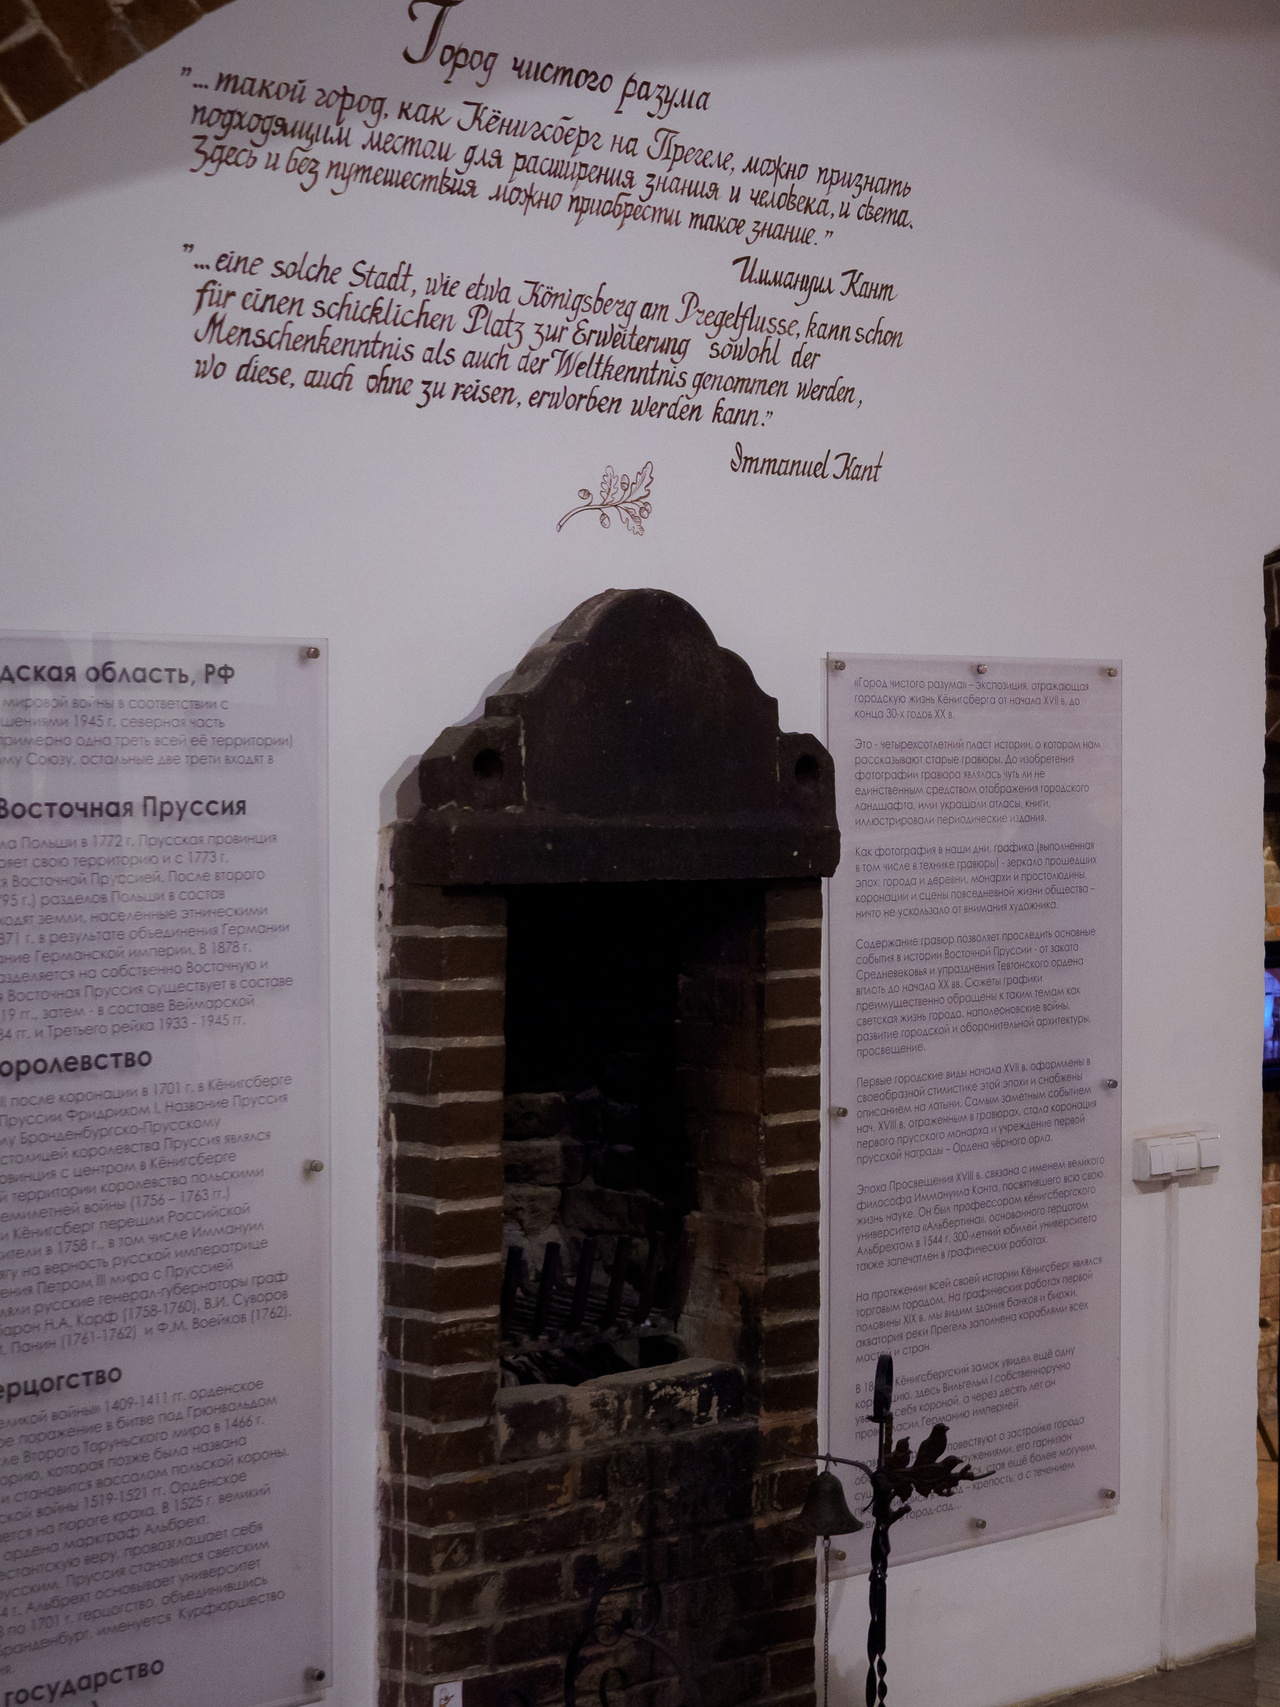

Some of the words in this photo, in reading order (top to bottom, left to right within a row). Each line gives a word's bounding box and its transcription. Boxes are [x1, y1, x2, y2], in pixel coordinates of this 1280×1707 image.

[403, 0, 498, 88] Город
[512, 57, 613, 93] чистого
[614, 72, 711, 120] разума
[314, 85, 388, 128] город,
[397, 100, 453, 126] как
[457, 100, 603, 157] Кёнигсберг
[610, 134, 638, 157] на
[647, 127, 735, 175] Прегеле,
[742, 155, 808, 187] можно
[816, 164, 912, 198] признать
[190, 104, 352, 148] подходящим
[362, 130, 456, 162] местом
[455, 144, 504, 175] для
[508, 151, 637, 191] расширения
[639, 172, 722, 202] знания
[728, 185, 741, 204] и
[750, 183, 834, 219] человека,
[839, 200, 850, 219] и
[857, 196, 913, 229] света.
[190, 135, 257, 176] Здесь
[264, 151, 280, 171] и
[286, 146, 320, 192] без
[326, 158, 479, 198] путешествия
[489, 179, 563, 219] можно
[568, 191, 681, 230] приобрести
[689, 211, 746, 236] такое
[271, 251, 342, 285] solche
[349, 260, 417, 297] Stadt,
[426, 272, 460, 298] wie
[466, 273, 511, 304] etwa
[518, 280, 638, 328] Königsberg
[640, 301, 669, 323] am
[675, 291, 801, 342] Pregelflusse,
[805, 311, 851, 342] kann
[855, 316, 903, 348] schon
[732, 256, 835, 306] Иммануил
[840, 269, 898, 301] Кант
[193, 279, 236, 316] für
[242, 288, 304, 317] einen
[312, 292, 457, 334] schicklichen
[463, 304, 525, 349] Platz
[529, 322, 568, 350] zur
[572, 319, 691, 364] Erweiterung
[709, 336, 781, 366] sowohl
[791, 342, 821, 370] der
[194, 312, 415, 362] Menschenkenntnis
[422, 338, 456, 366] als
[462, 344, 512, 372] auch
[517, 349, 551, 376] der
[551, 348, 687, 389] Weltkenntnis
[685, 370, 788, 400] genommen
[797, 376, 862, 409] werden,
[194, 353, 227, 380] wo
[236, 354, 295, 389] diese,
[304, 363, 356, 392] auch
[366, 364, 413, 396] ohne
[415, 378, 446, 408] zu
[451, 379, 521, 409] reisen,
[528, 386, 622, 415] erworben
[630, 395, 703, 423] werden
[731, 442, 829, 480] Immanuel
[833, 451, 883, 482] Kant
[86, 661, 196, 686] область,
[204, 663, 235, 685] РФ
[889, 679, 925, 688] чистого
[975, 681, 1029, 692] экспозиция,
[1031, 683, 1088, 693] отражающая
[854, 694, 906, 705] городскую
[908, 695, 935, 703] жизнь
[937, 693, 995, 706] Кёнигсберга
[1009, 696, 1041, 705] начала
[854, 709, 883, 719] конца
[885, 708, 904, 718] 30-х
[906, 710, 932, 719] годов
[142, 795, 247, 822] Пруссия
[854, 786, 923, 795] единственным
[925, 785, 976, 796] средством
[978, 784, 1038, 795] отображения
[1040, 784, 1089, 794] городского
[21, 836, 77, 849] Польши
[93, 833, 122, 847] 1772
[138, 833, 204, 848] Прусская
[207, 833, 277, 846] провинция
[855, 937, 918, 949] Содержание
[920, 936, 954, 947] гравюр
[956, 933, 999, 943] позволяет
[1001, 930, 1052, 942] проследить
[1054, 928, 1095, 938] основные
[8, 988, 80, 1001] Восточная
[84, 984, 143, 999] Пруссия
[147, 980, 226, 996] существует
[240, 976, 293, 989] составе
[11, 1094, 55, 1106] после
[58, 1088, 138, 1103] коронации
[153, 1081, 179, 1095] 1701
[207, 1074, 292, 1090] Кёнигсберге
[856, 1183, 886, 1195] Эпоха
[889, 1175, 953, 1192] Просвещения
[984, 1166, 1019, 1178] связана
[1029, 1161, 1065, 1172] именем
[1067, 1156, 1104, 1168] великого
[856, 1195, 911, 1211] философа
[914, 1187, 969, 1202] Иммануила
[1002, 1176, 1061, 1190] посвятившего
[1063, 1173, 1080, 1183] всю
[1081, 1170, 1103, 1180] свою
[871, 1284, 926, 1301] протяжении
[929, 1280, 950, 1290] всей
[952, 1273, 979, 1287] своей
[982, 1270, 1019, 1281] истории
[1020, 1261, 1069, 1275] Кёнигсберг
[1072, 1256, 1102, 1267] являлся
[11, 1340, 56, 1352] Панин
[192, 1313, 246, 1329] Воейков
[4, 1659, 164, 1707] государство
